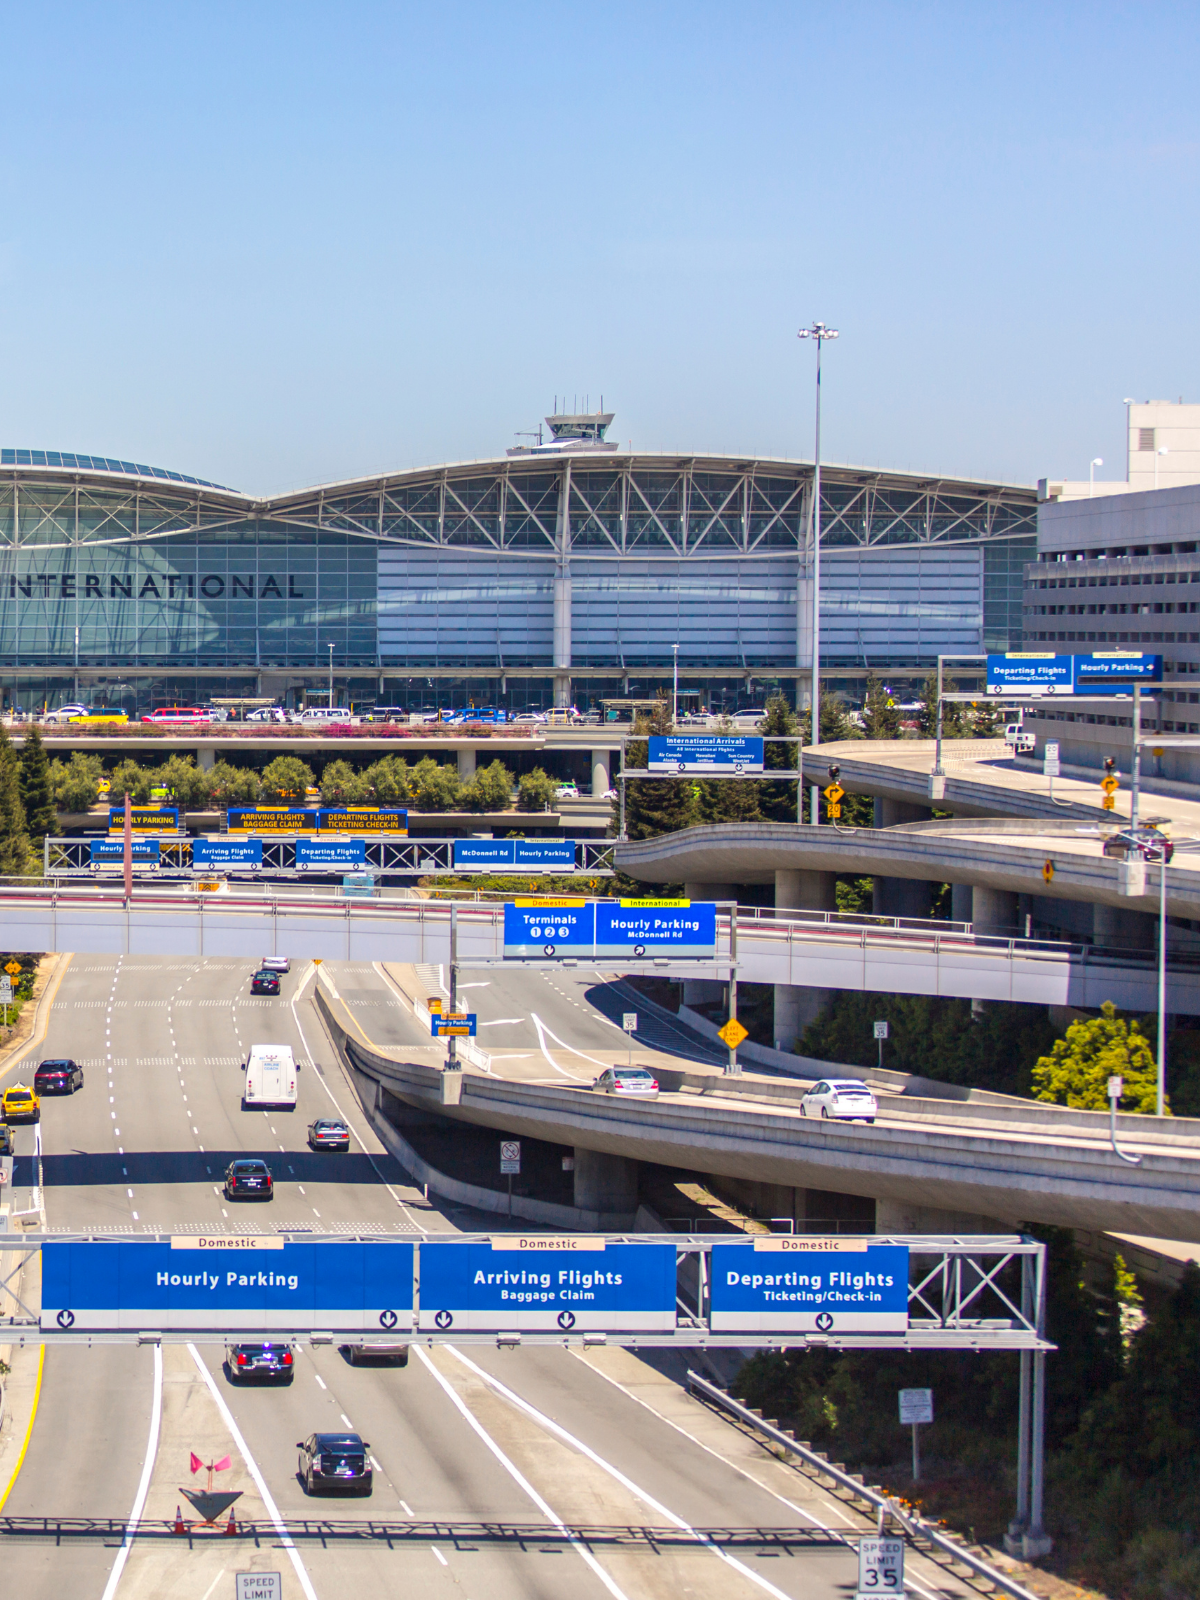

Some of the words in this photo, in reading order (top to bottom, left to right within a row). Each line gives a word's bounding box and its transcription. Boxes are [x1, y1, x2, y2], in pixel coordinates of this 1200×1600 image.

[993, 667, 1035, 676] Departing
[1037, 667, 1066, 675] Flights
[1080, 664, 1109, 673] Hourly
[1111, 664, 1144, 673] Parking
[828, 805, 839, 813] 20
[113, 816, 141, 824] HORLY
[142, 816, 174, 824] PARKING
[276, 813, 305, 821] FLIGHTS
[100, 845, 123, 853] Hourly
[128, 845, 151, 853] rking
[201, 848, 230, 856] Arriving
[230, 848, 254, 856] Flights
[301, 848, 335, 856] Departing
[336, 848, 360, 856] Flights
[543, 850, 570, 858] Parking
[523, 914, 577, 925] Terminals
[610, 919, 651, 931] Hourly
[654, 919, 700, 931] Parking
[625, 1021, 635, 1029] 35
[198, 1237, 257, 1248] Domestic
[519, 1239, 578, 1250] Domestic
[781, 1240, 840, 1251] Domestic
[156, 1271, 220, 1290] Hourly
[226, 1271, 299, 1290] Parking
[473, 1270, 552, 1288] Arriving
[558, 1270, 623, 1288] Flights
[726, 1271, 822, 1290] Departing
[829, 1271, 894, 1290] Flights
[501, 1290, 556, 1303] Baggage
[560, 1289, 596, 1301] Claim
[763, 1290, 882, 1304] Ticketing/Check-in
[863, 1543, 901, 1553] SPEED
[866, 1556, 896, 1565] LIMIT
[243, 1578, 275, 1587] SPEED
[865, 1568, 898, 1587] 35
[244, 1590, 274, 1600] LIMIT
